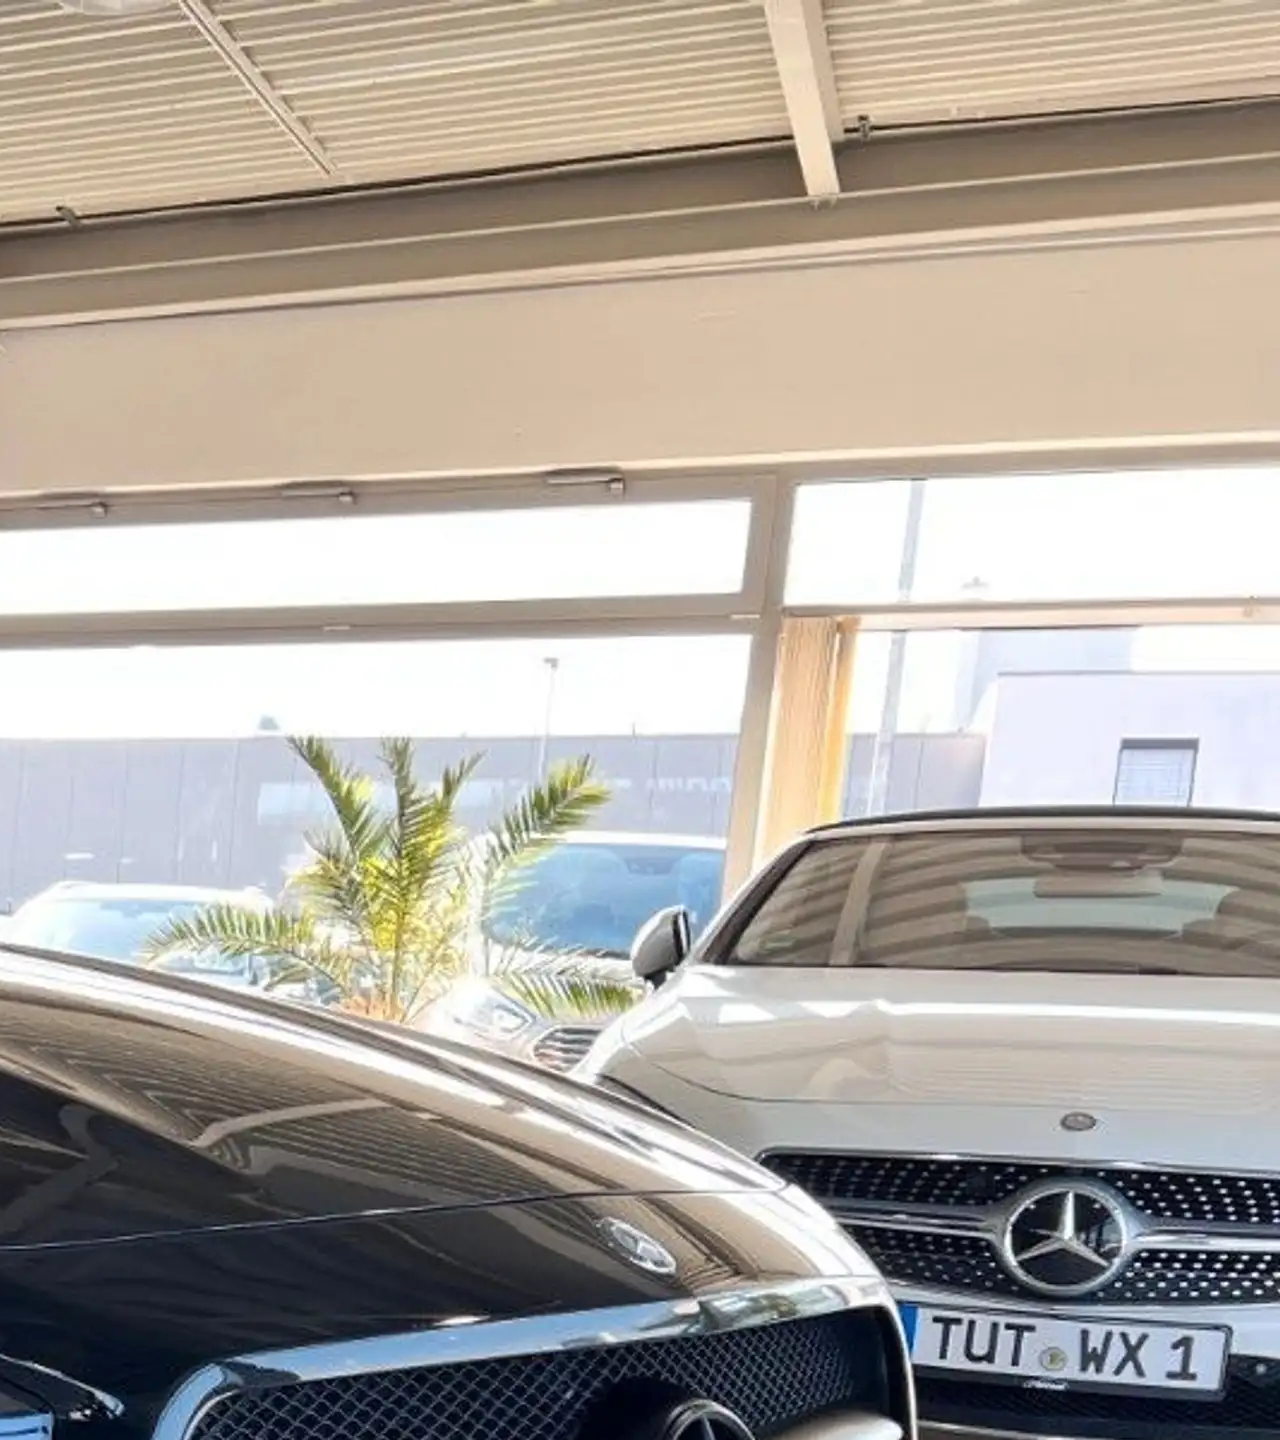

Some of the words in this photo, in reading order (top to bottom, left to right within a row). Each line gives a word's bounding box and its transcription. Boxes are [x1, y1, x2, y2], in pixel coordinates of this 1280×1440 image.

[932, 1316, 1036, 1367] TUT
[1079, 1328, 1149, 1378] WX
[1166, 1335, 1197, 1381] 1
